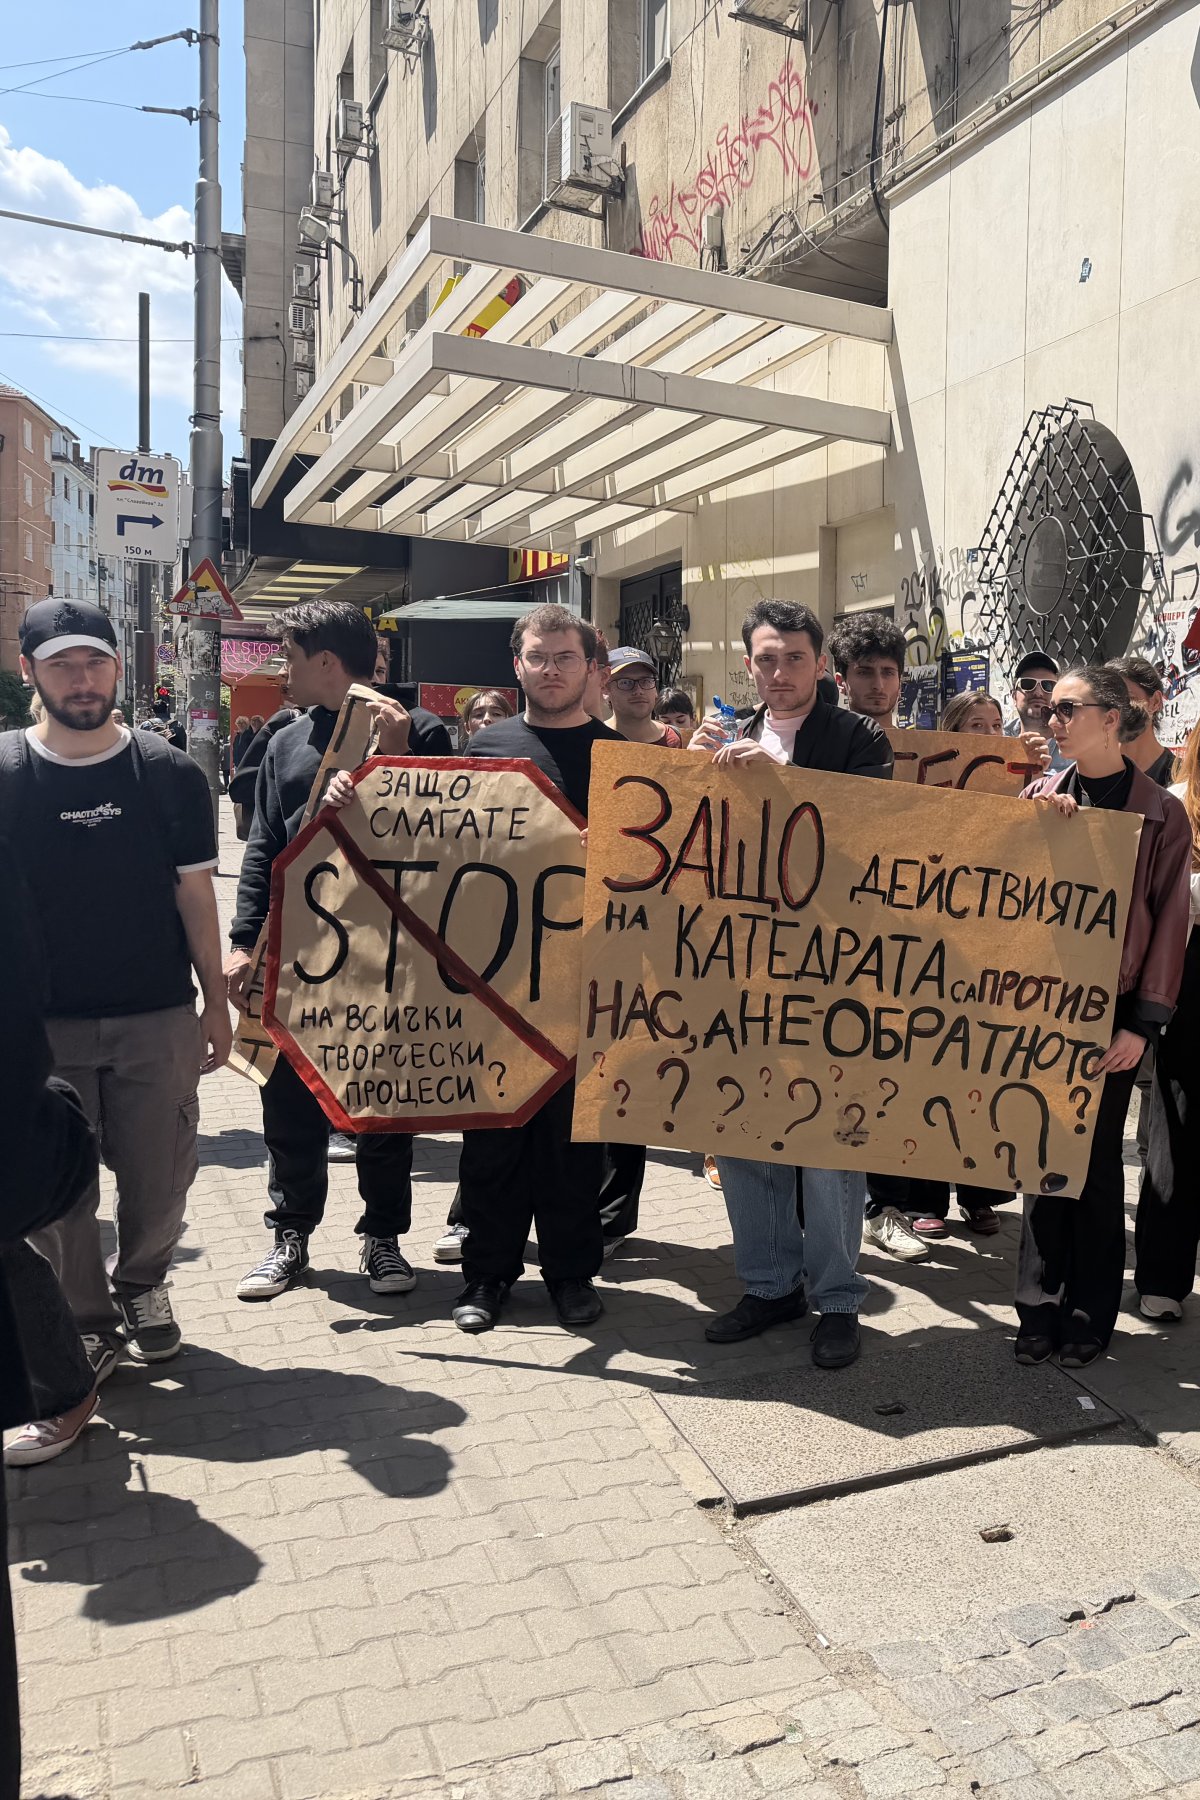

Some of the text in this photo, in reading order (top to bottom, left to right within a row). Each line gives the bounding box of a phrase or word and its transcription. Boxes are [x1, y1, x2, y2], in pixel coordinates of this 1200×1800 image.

[119, 459, 164, 484] dm
[124, 545, 141, 555] 150
[241, 641, 280, 656] STOP
[376, 770, 471, 801] ЗАЩО
[370, 807, 530, 841] СЛАГАТЕ
[602, 775, 825, 912] ЗАЩО
[850, 851, 1117, 939] ДЕЙСТВИЯТА
[293, 860, 586, 1002] STOP
[605, 900, 947, 999] НА КАТЕДРАТА
[977, 969, 1110, 1024] ПРОТИВ
[301, 1004, 462, 1032] НА ВСИЧКИ
[318, 1043, 484, 1071] ТВОРЧЕСКИ
[823, 998, 1107, 1086] ОБРАТНОТО
[345, 1076, 476, 1108] ПРОЦЕСИ
